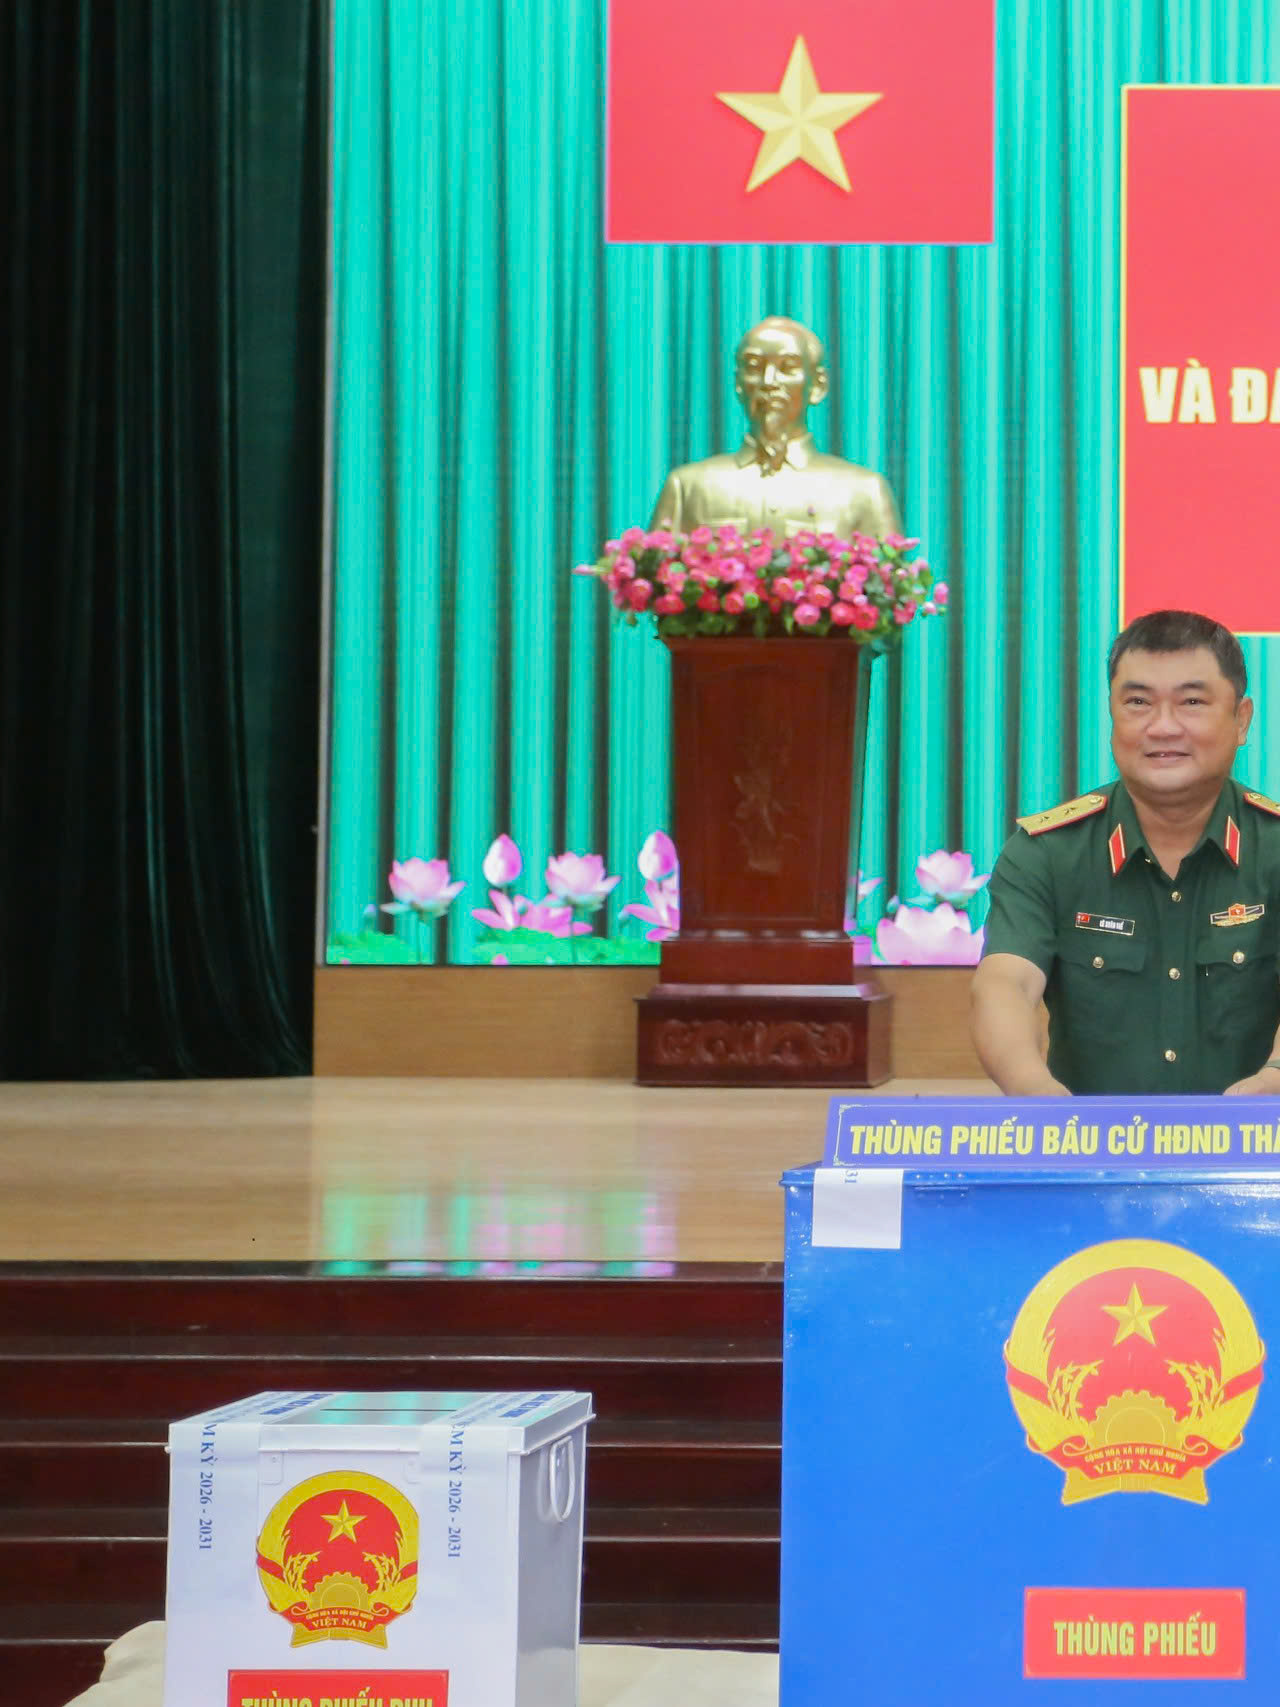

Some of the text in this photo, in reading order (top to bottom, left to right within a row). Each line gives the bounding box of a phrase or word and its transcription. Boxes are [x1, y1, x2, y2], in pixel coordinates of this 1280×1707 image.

[1140, 358, 1217, 424] VÀ
[850, 1120, 941, 1155] THÙNG
[951, 1117, 1034, 1155] PHIẾU
[1043, 1115, 1099, 1155] BẦU
[1108, 1116, 1148, 1154] CỬ
[1155, 1125, 1230, 1154] HĐND
[201, 1442, 218, 1466] KỲ
[449, 1451, 466, 1474] KỲ
[1093, 1458, 1176, 1474] VIỆT NAM
[200, 1471, 213, 1505] 2026
[449, 1480, 462, 1513] 2026
[199, 1518, 213, 1549] 2031
[448, 1527, 461, 1557] 2031
[311, 1617, 368, 1629] VIỆT NAM
[1053, 1609, 1217, 1657] THÙNG PHIẾU
